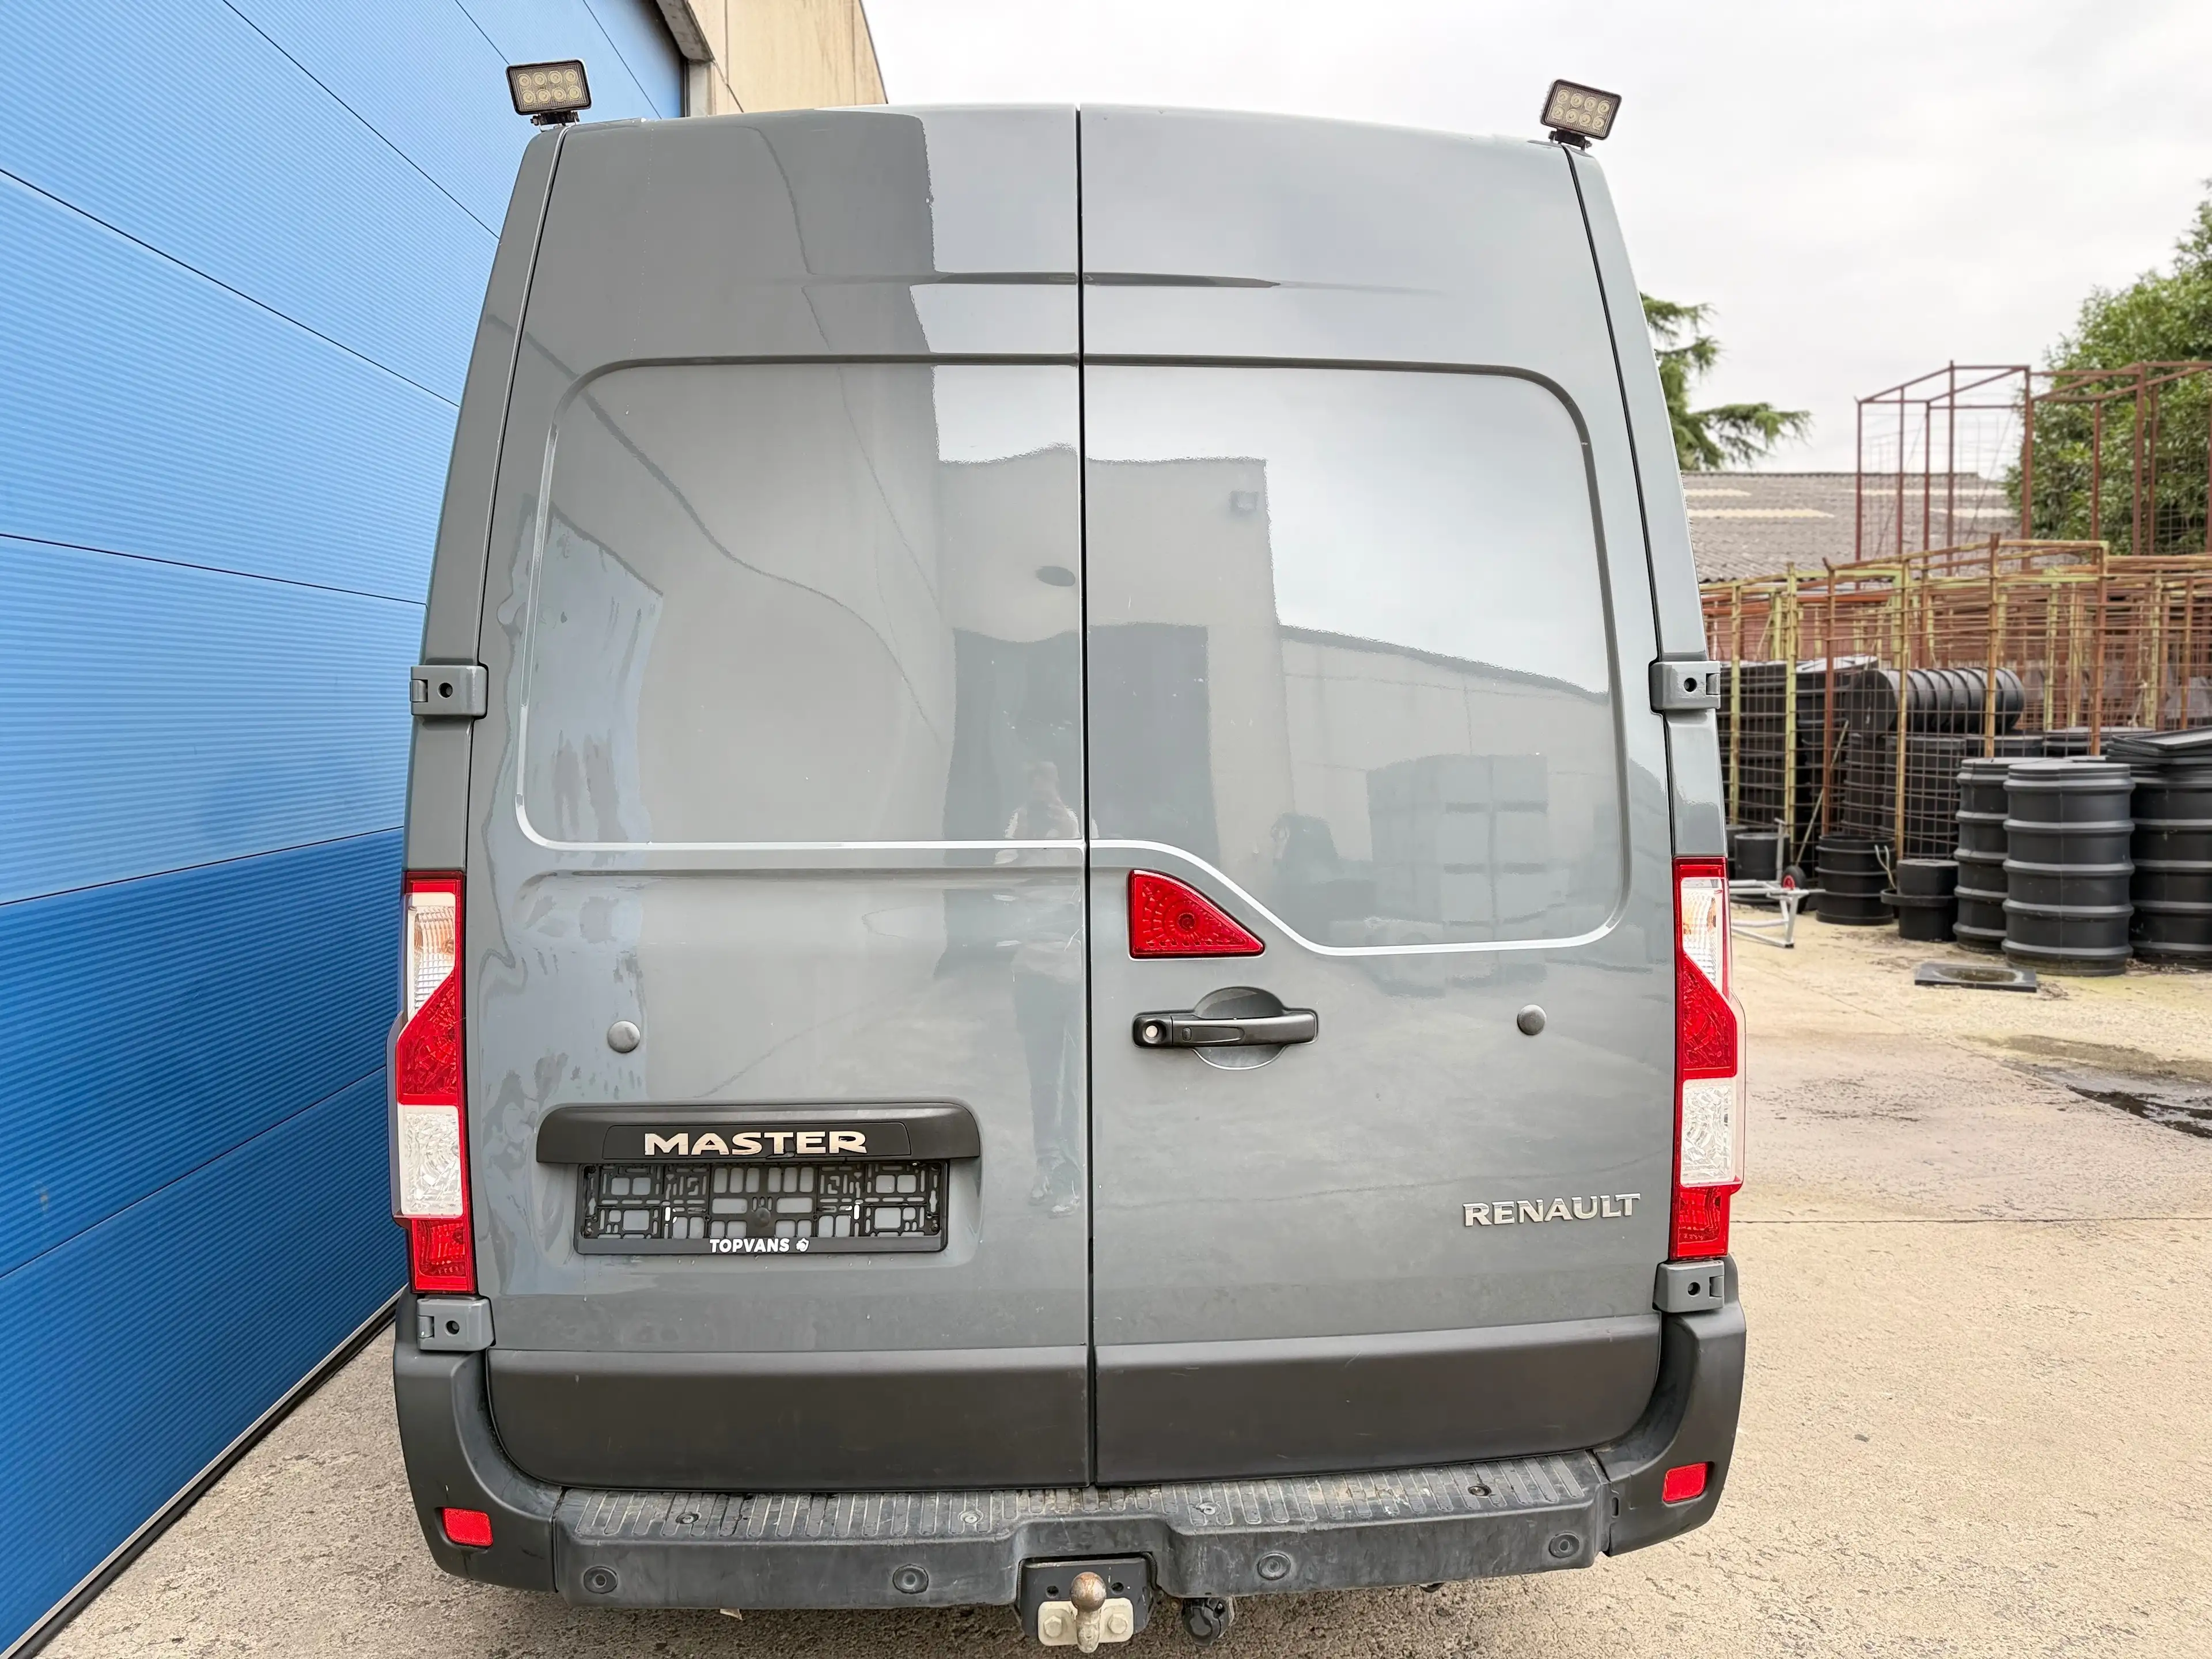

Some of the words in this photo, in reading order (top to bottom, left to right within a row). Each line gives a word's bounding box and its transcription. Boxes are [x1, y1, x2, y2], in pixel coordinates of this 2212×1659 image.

[644, 1131, 868, 1156] MASTER
[1463, 1192, 1641, 1227] RENAULT
[709, 1237, 790, 1253] TOPVANS
